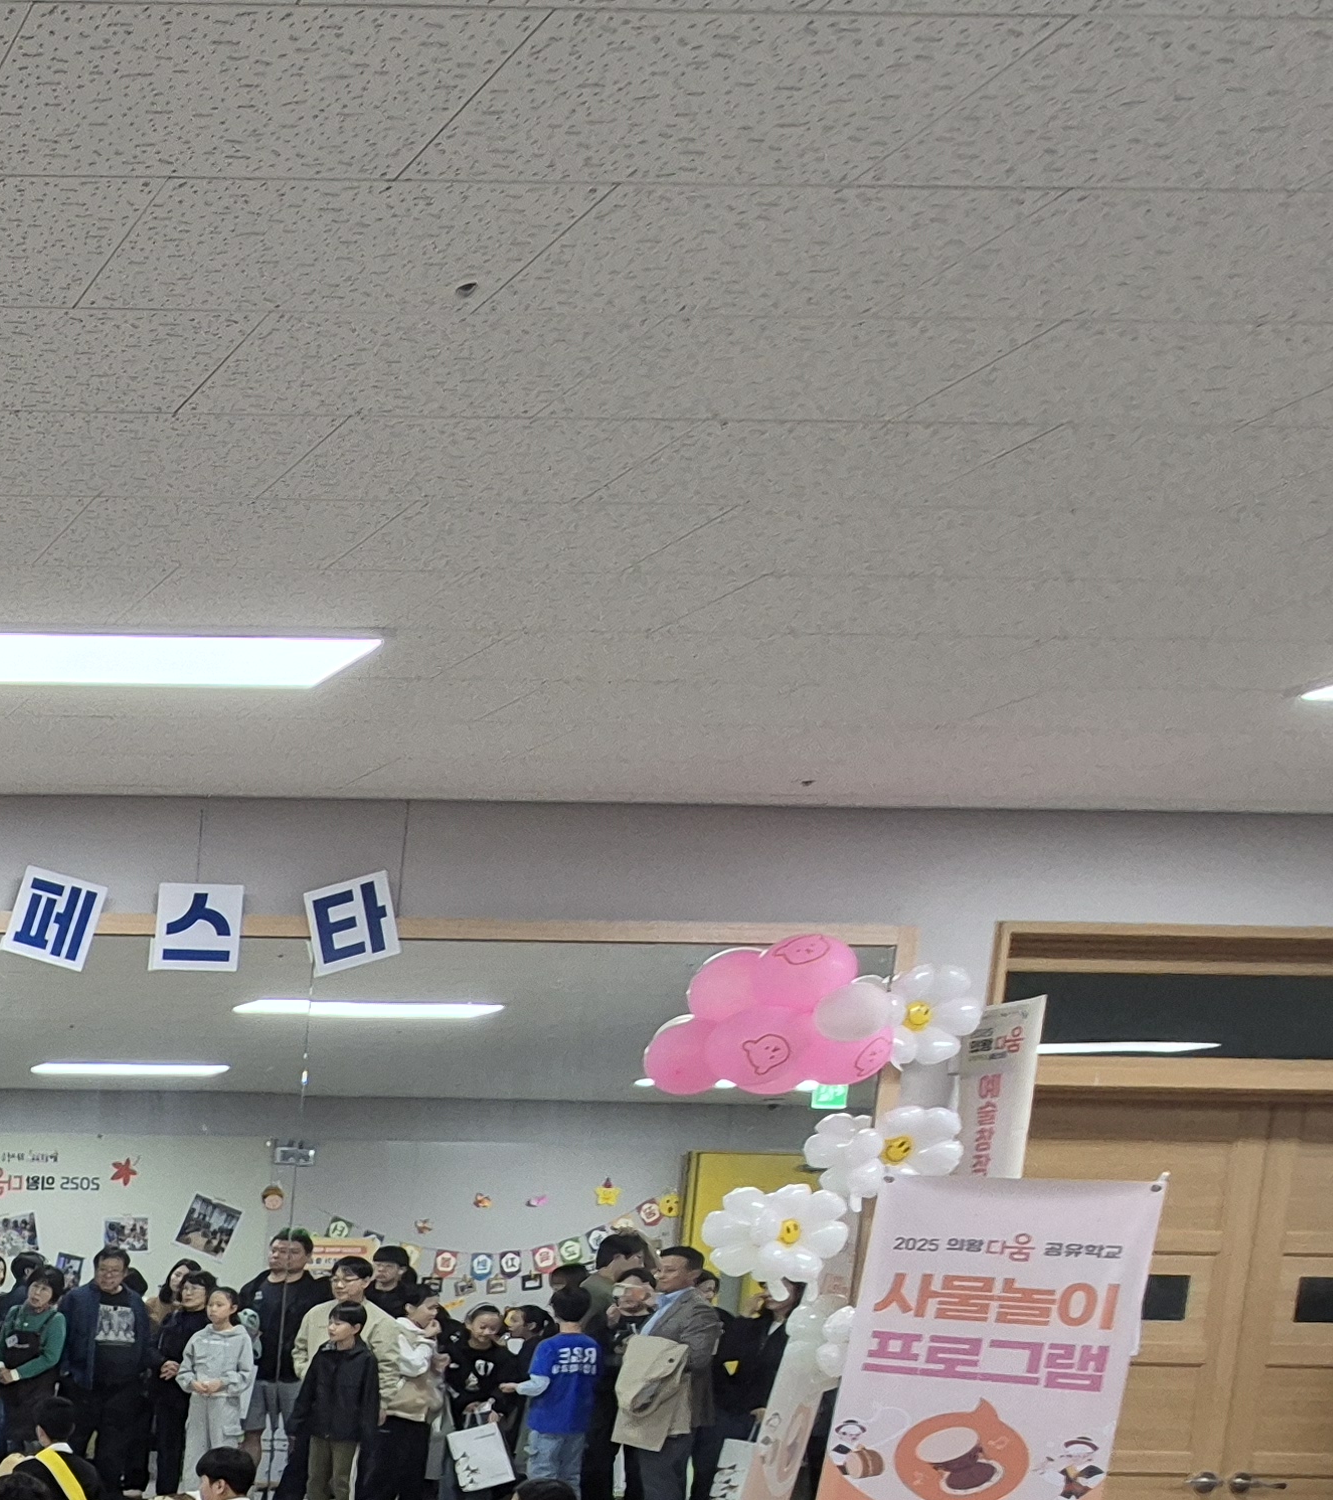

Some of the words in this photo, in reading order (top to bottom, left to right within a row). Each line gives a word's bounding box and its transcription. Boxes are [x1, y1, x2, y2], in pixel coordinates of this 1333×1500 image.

[12, 876, 388, 965] 페스타
[893, 1236, 940, 1252] 2025
[946, 1238, 984, 1253] 의왕
[985, 1232, 1036, 1262] 다움
[1043, 1241, 1124, 1260] 공유학교
[873, 1271, 1121, 1331] 사물놀이
[861, 1329, 1111, 1393] 프로그램
